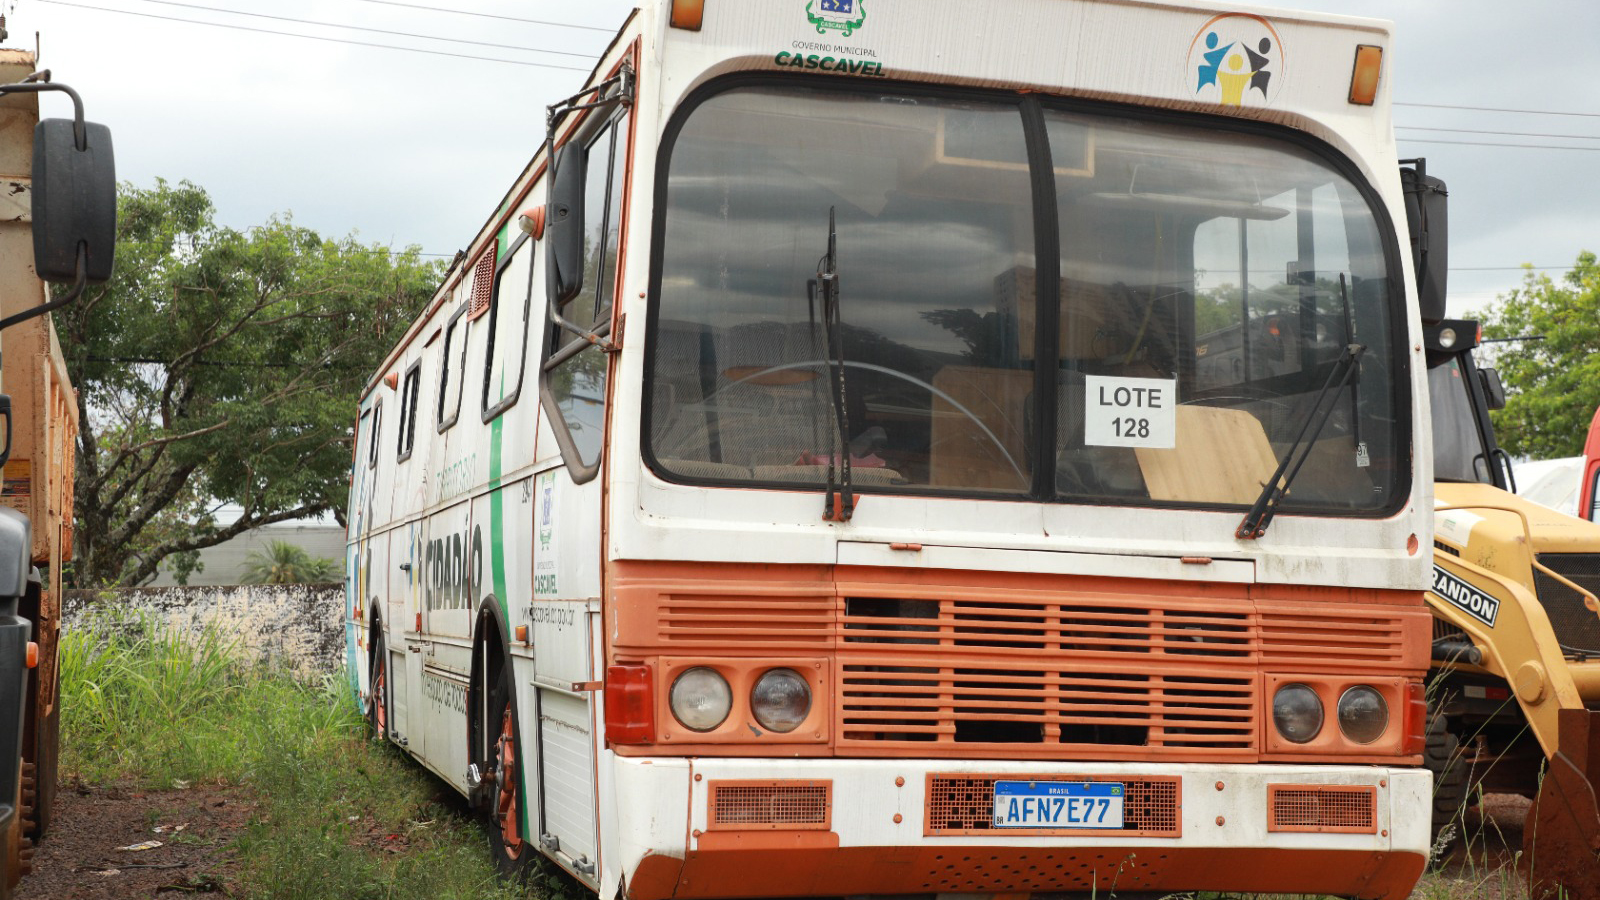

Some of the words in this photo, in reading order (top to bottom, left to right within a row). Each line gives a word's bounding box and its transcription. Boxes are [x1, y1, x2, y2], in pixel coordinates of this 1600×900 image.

[792, 40, 831, 52] GOVERNO
[833, 45, 877, 57] MUNICIPAL
[774, 51, 885, 77] CASCAVEL
[1099, 386, 1162, 408] LOTE
[1111, 417, 1150, 438] 128
[1432, 570, 1495, 620] RANDON
[1049, 787, 1070, 795] BRASIL
[1007, 797, 1111, 823] AFN7E77
